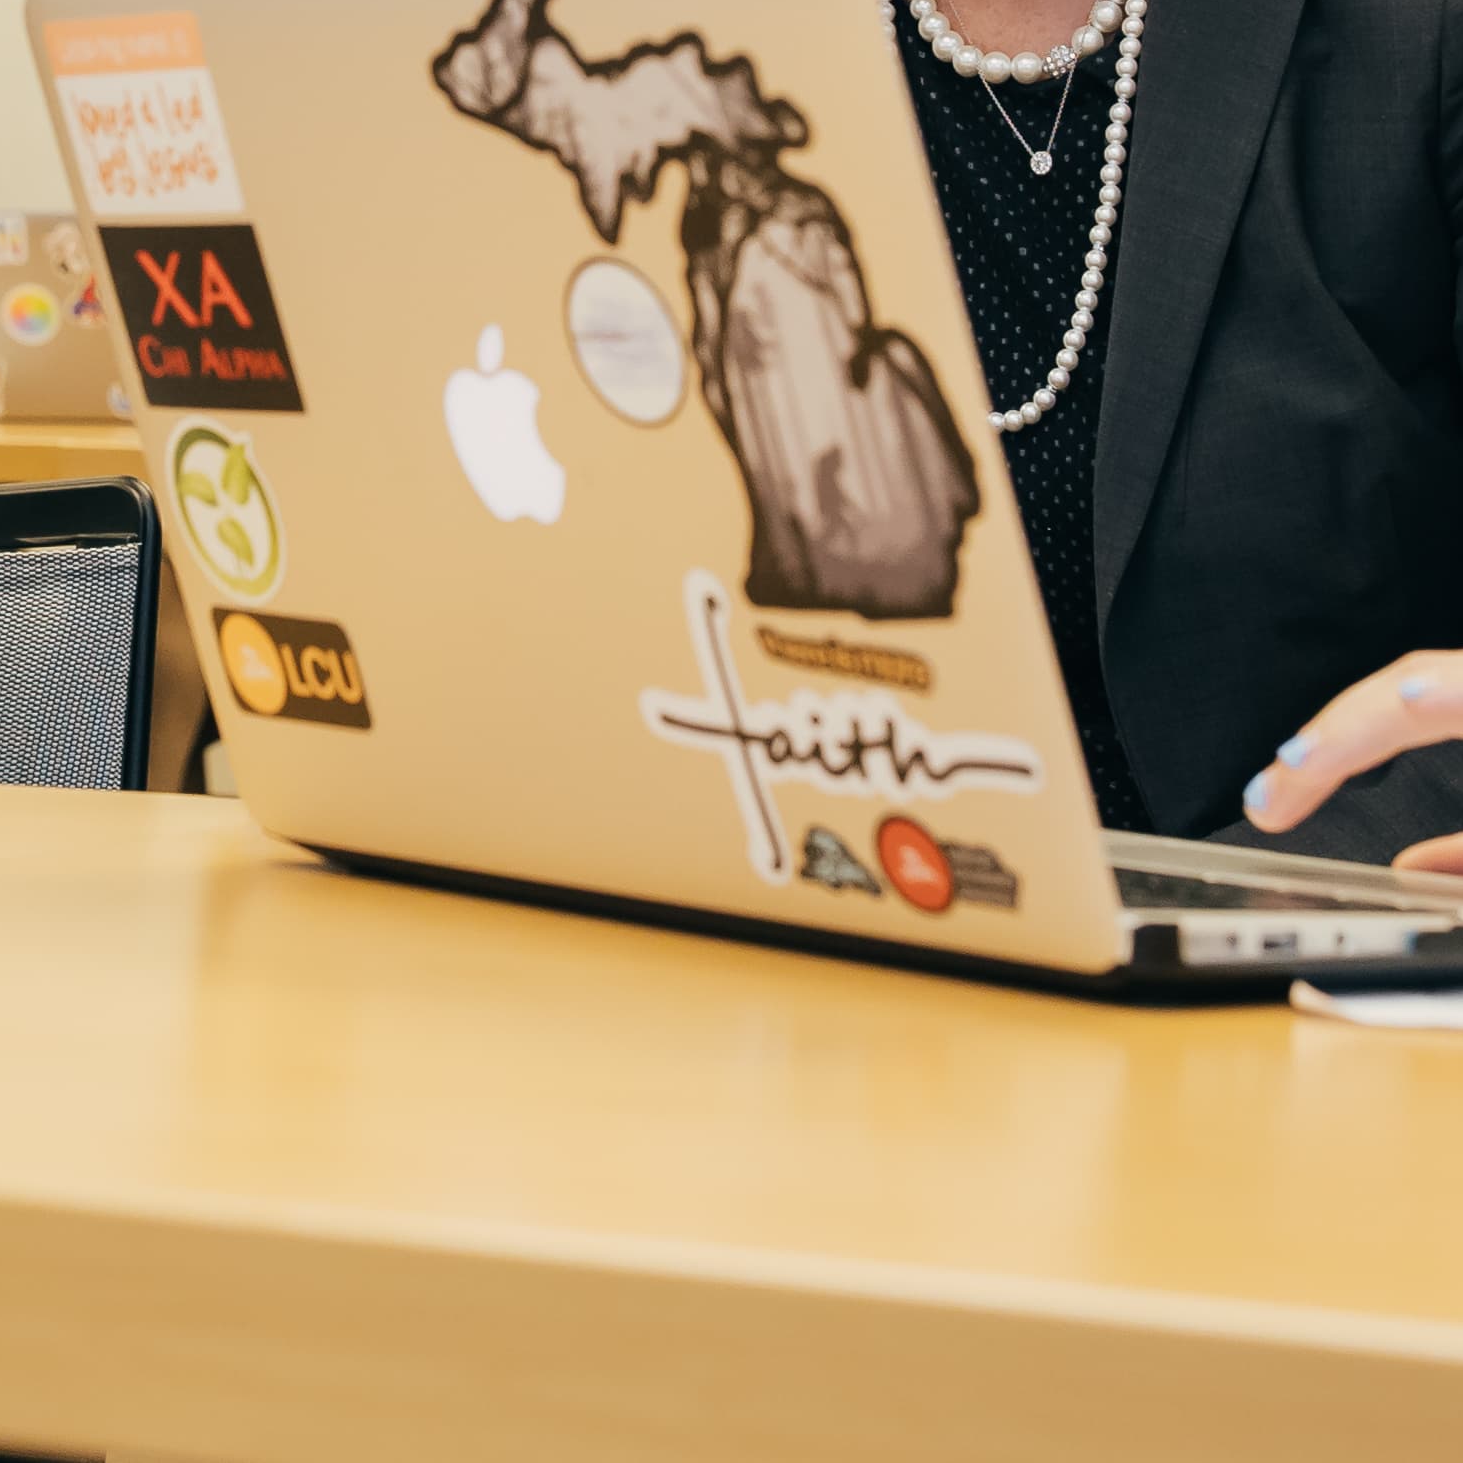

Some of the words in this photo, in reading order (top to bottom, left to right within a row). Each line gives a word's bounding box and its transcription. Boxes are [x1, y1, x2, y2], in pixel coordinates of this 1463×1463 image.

[135, 249, 253, 329] XA
[280, 644, 364, 705] LCU
[660, 593, 1034, 872] faith
